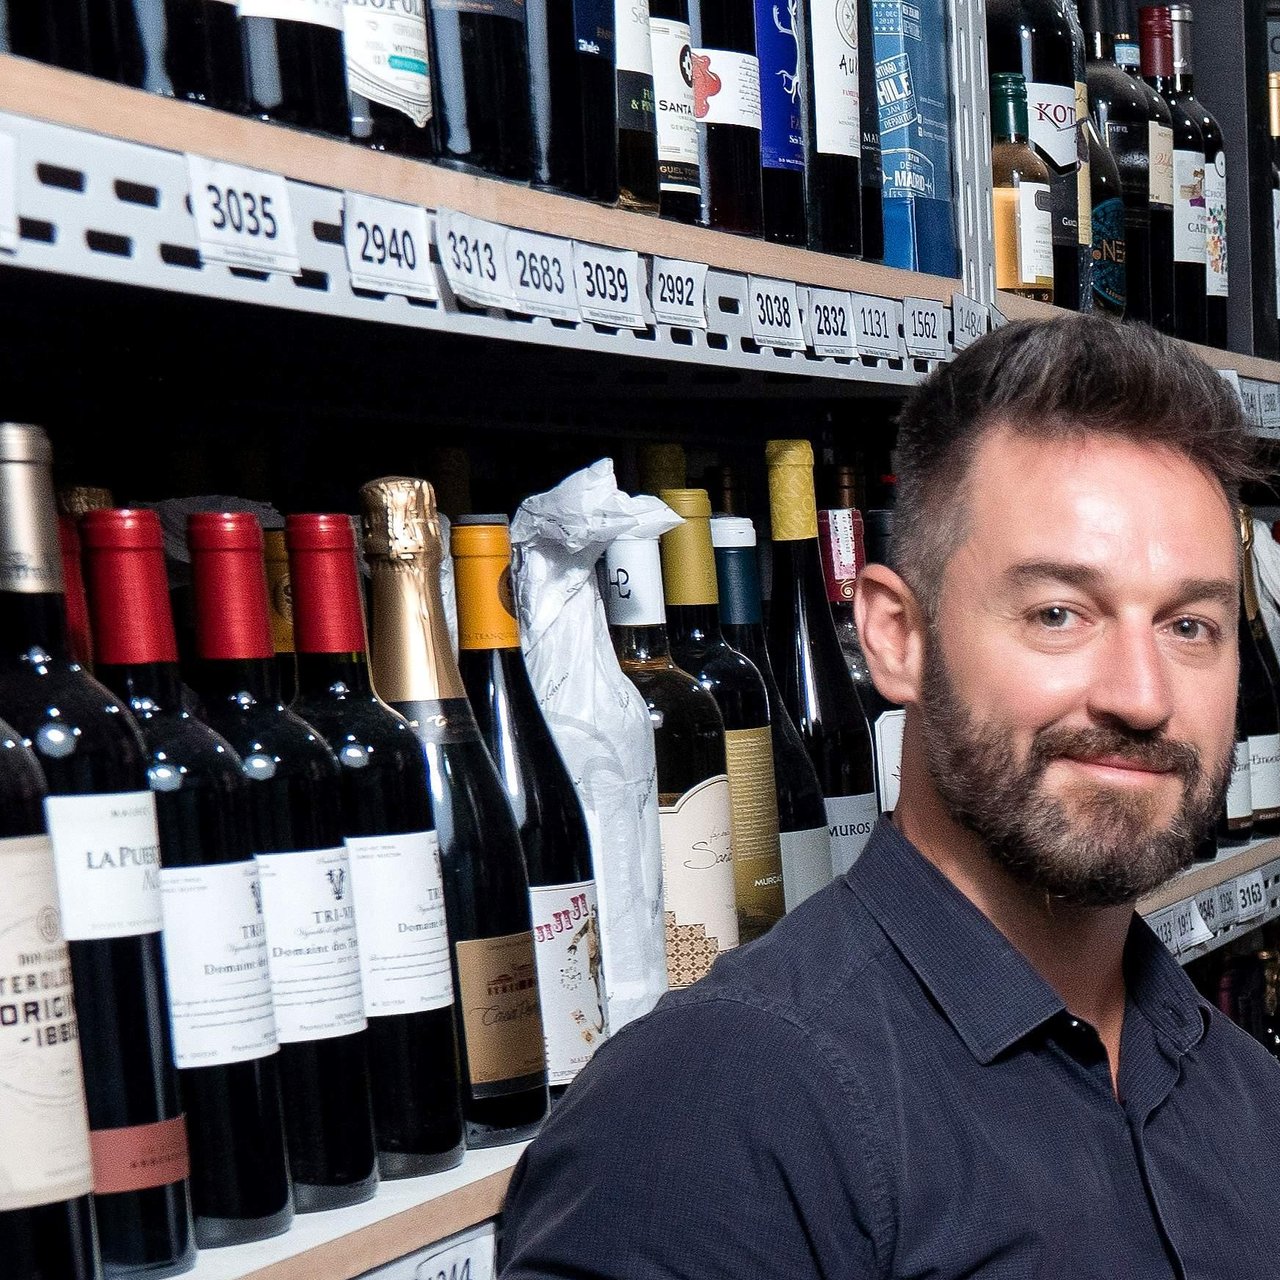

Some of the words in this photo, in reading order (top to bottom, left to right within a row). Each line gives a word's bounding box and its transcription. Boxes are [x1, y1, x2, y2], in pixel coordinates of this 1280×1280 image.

[659, 100, 692, 114] SANTA
[206, 184, 278, 239] 3035
[357, 221, 417, 271] 2940
[447, 230, 498, 282] 3313
[515, 248, 565, 296] 2683
[582, 260, 629, 304] 3039
[657, 272, 695, 307] 2992
[756, 292, 792, 329] 3038
[815, 303, 848, 337] 2832
[860, 306, 890, 339] 1131
[911, 310, 938, 339] 1562
[827, 821, 871, 838] MUROS
[1239, 883, 1263, 909] 3163
